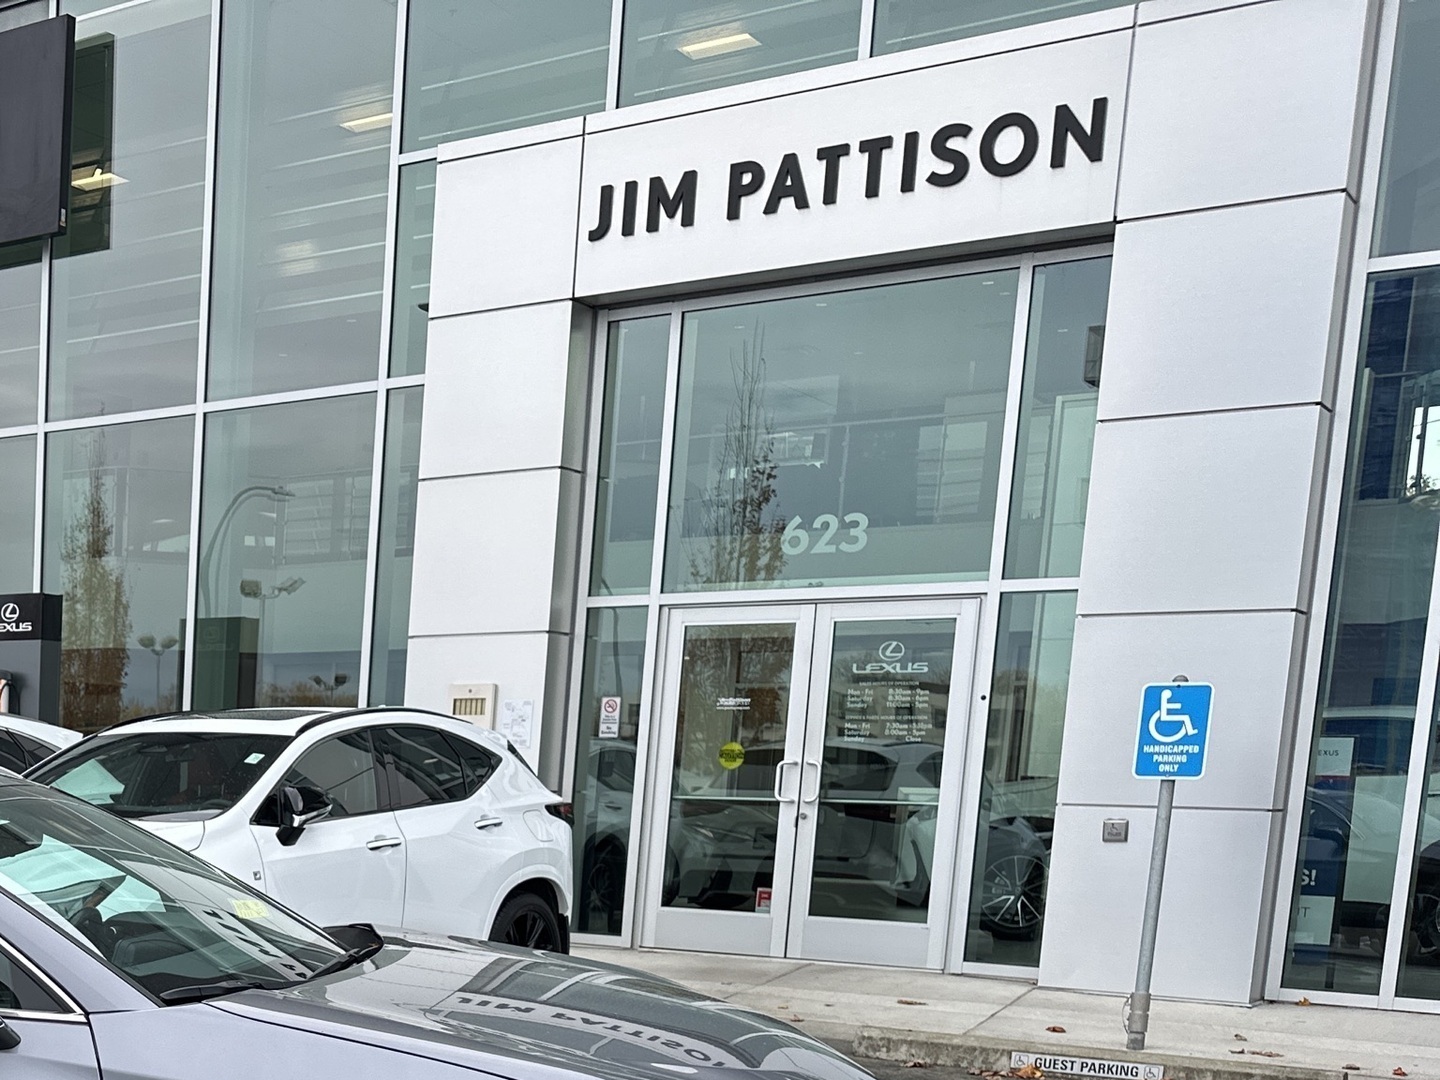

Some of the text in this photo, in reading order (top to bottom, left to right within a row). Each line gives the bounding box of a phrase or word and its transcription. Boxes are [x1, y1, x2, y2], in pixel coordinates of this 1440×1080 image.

[588, 97, 1108, 241] JIM PATTISON
[781, 512, 869, 555] 623
[852, 662, 929, 674] LEXUS
[1143, 745, 1200, 753] HANDICAPPED
[1153, 755, 1187, 763] PARKING
[1158, 764, 1179, 772] ONLY
[1034, 1056, 1139, 1078] GUEST PARKING
